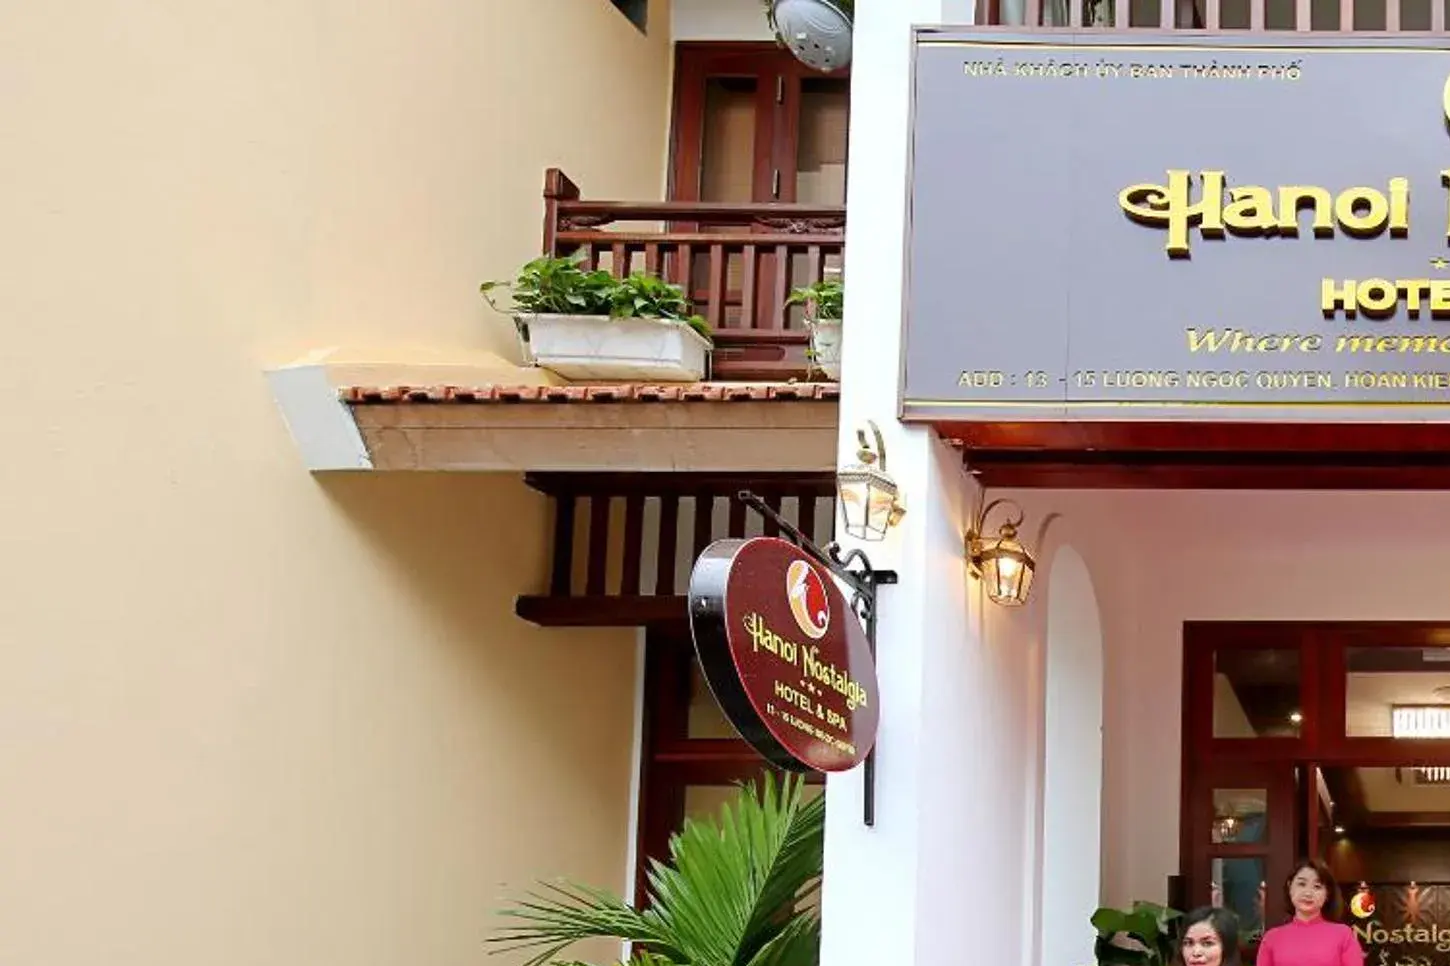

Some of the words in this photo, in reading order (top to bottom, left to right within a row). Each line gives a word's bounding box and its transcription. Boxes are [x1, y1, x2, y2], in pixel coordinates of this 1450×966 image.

[1129, 62, 1174, 79] BAN
[1119, 168, 1409, 260] Hanoi
[1186, 327, 1323, 354] Where
[958, 370, 1003, 388] ADD
[1073, 370, 1096, 388] 15
[1102, 370, 1180, 389] LUONG
[1186, 370, 1249, 389] NGOC
[1344, 370, 1407, 389] HOAN
[743, 612, 798, 666] Hanoi
[802, 645, 868, 711] Nostalgia
[774, 680, 814, 714] HOTEL
[827, 708, 848, 732] SPA
